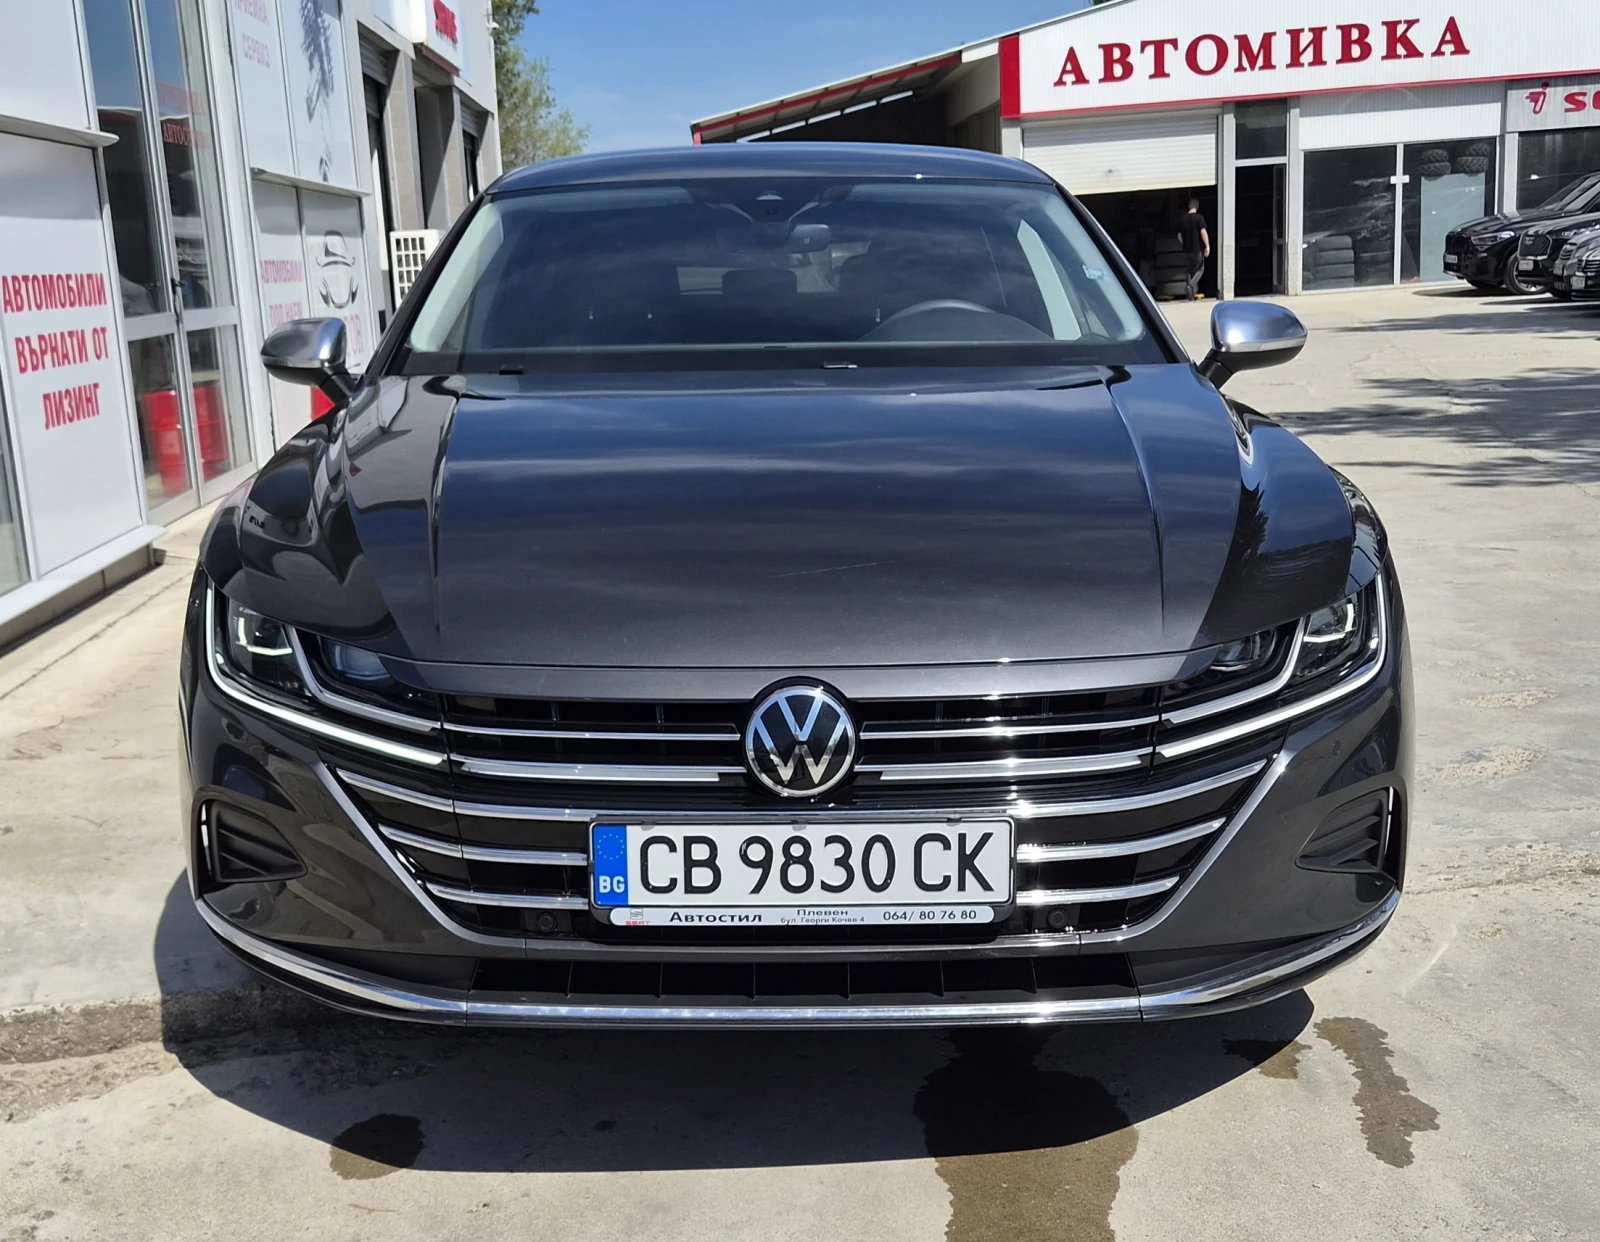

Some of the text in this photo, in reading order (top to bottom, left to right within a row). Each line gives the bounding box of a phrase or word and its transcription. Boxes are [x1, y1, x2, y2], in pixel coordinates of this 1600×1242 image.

[1053, 16, 1471, 88] АВТОМИВКА
[2, 273, 108, 314] АВТОМОБИЛИ
[15, 327, 109, 374] ВЪРНАТИ ОТ
[43, 383, 100, 430] ЛИЗИНГ
[640, 832, 995, 895] CB 9830 CK
[598, 875, 626, 894] BG
[669, 911, 762, 923] Автостил
[797, 908, 849, 916] Плевен
[883, 909, 977, 922] 064/ 80 76 80
